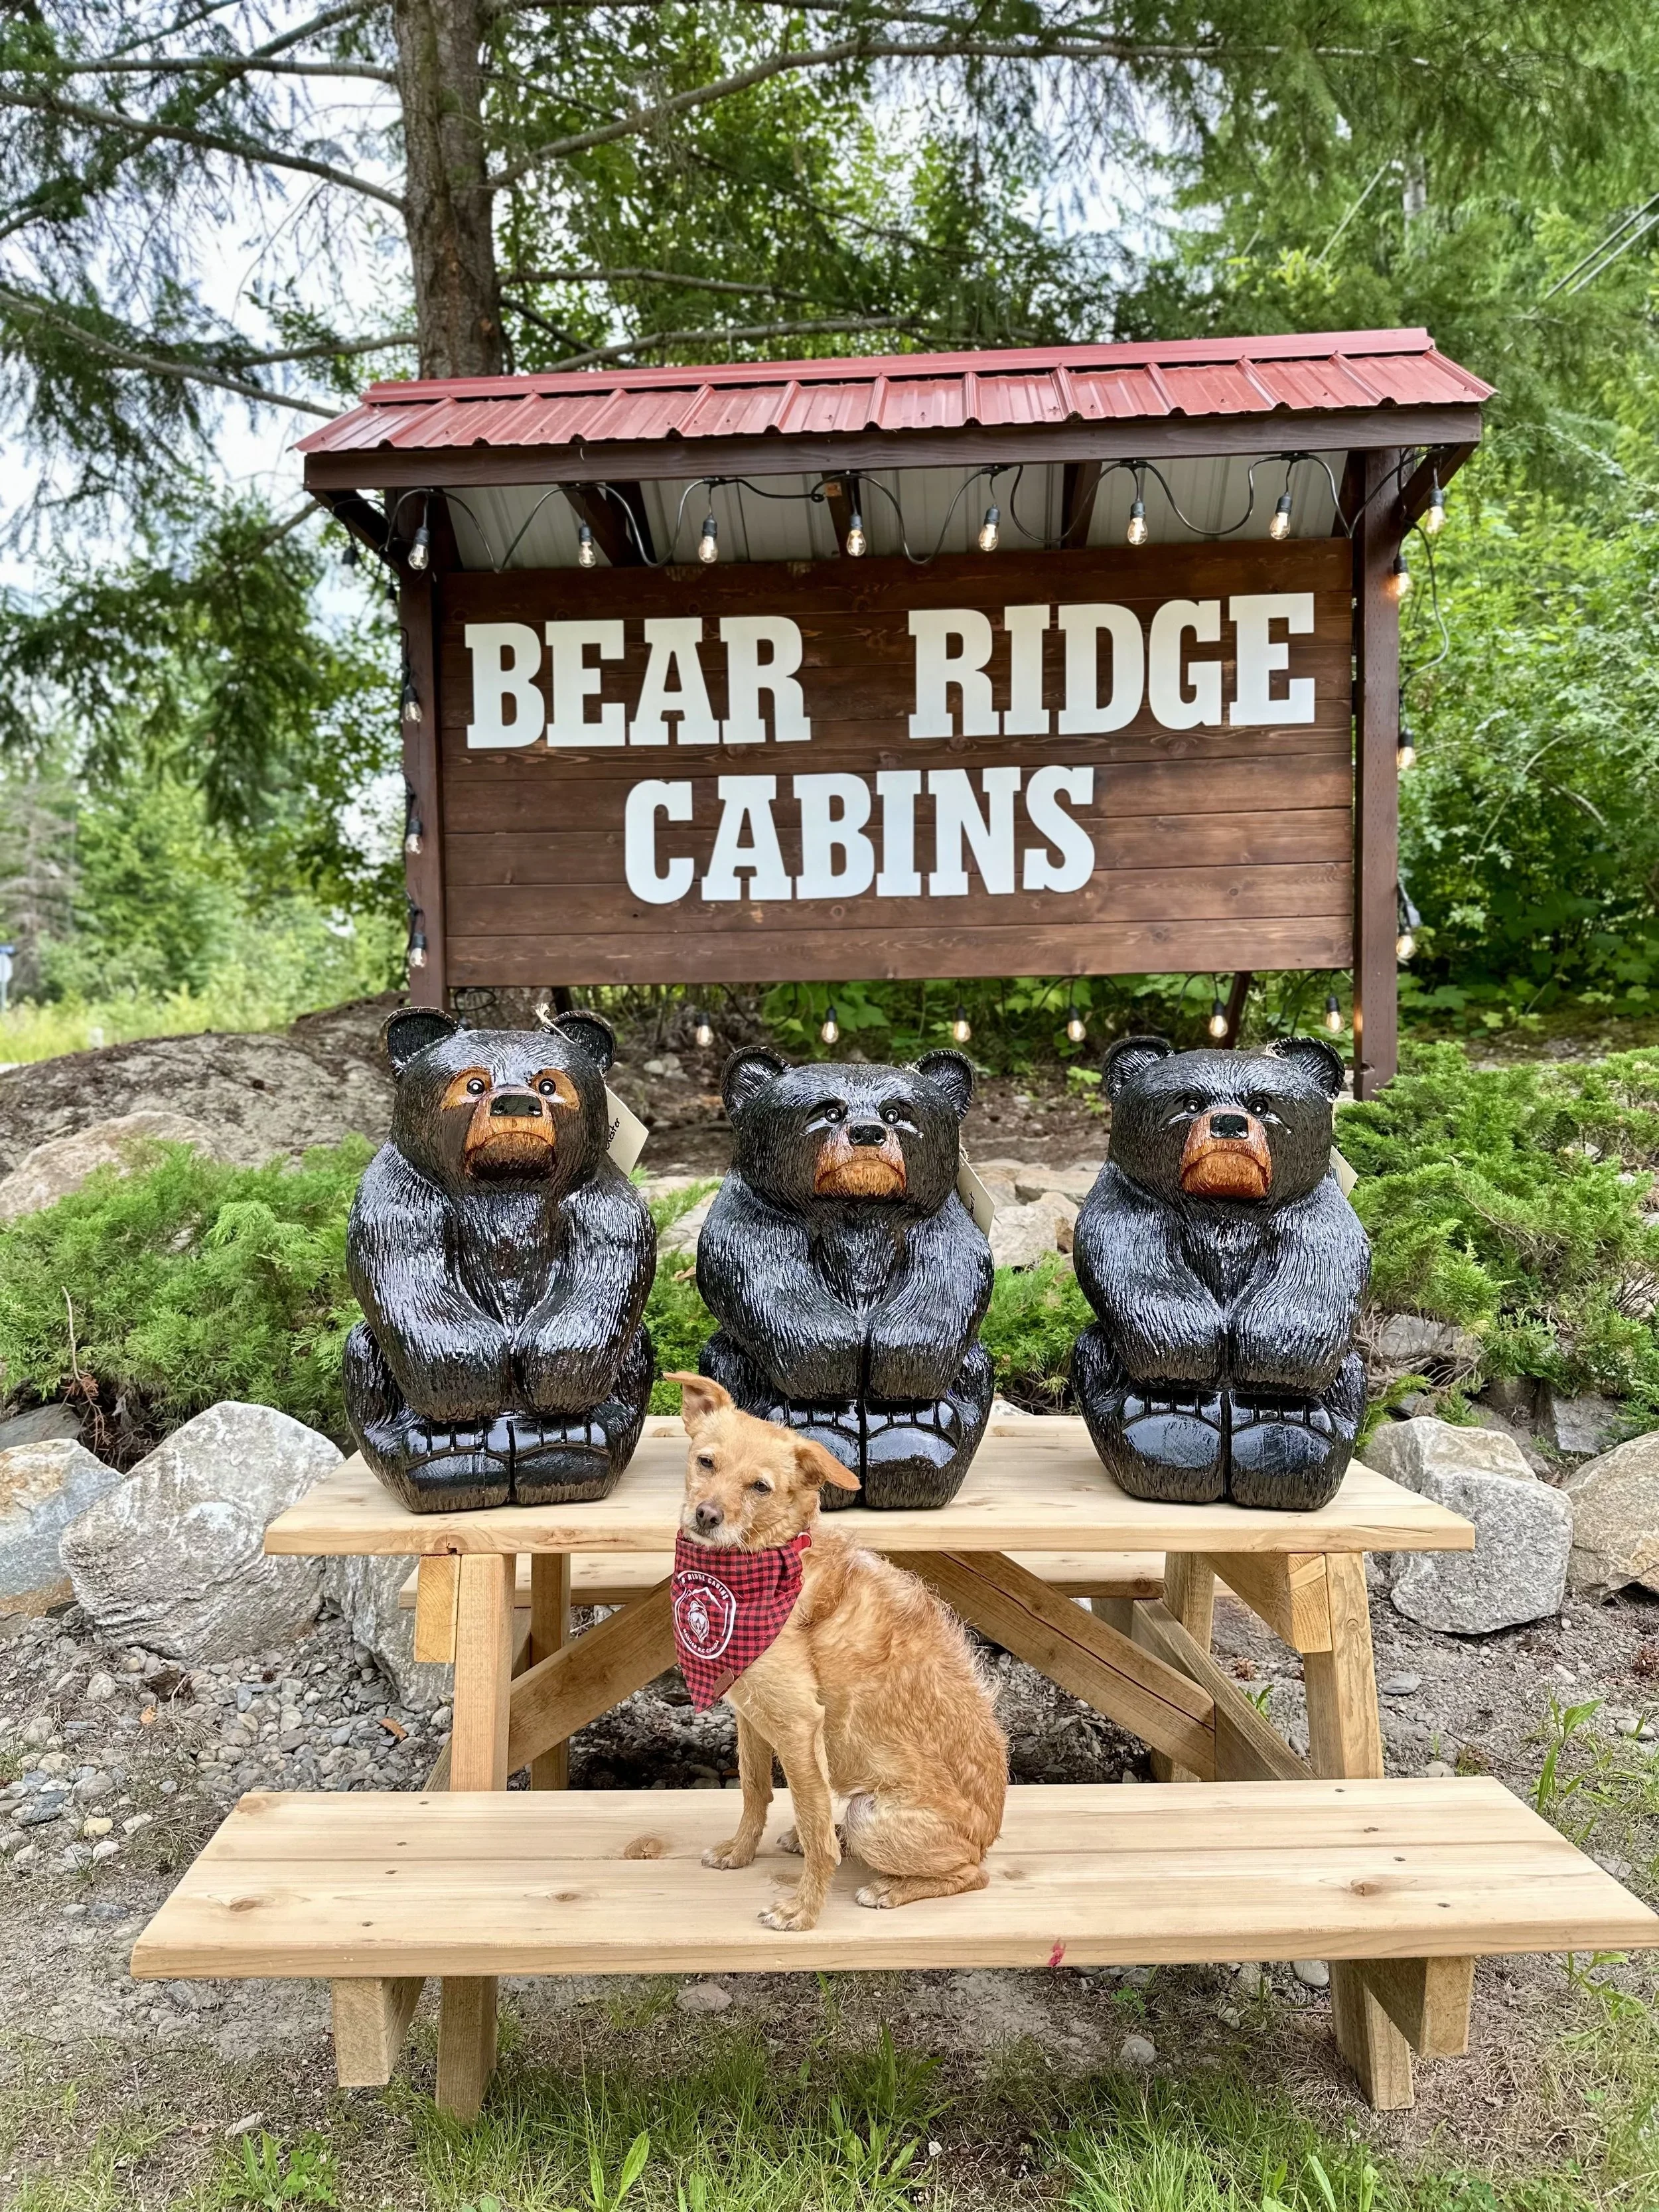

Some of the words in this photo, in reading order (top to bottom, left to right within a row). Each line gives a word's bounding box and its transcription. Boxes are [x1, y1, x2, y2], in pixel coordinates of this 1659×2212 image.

[465, 616, 811, 749] BEAR
[908, 593, 1315, 739] RIDGE
[624, 765, 1095, 904] CABINS
[707, 1578, 729, 1599] CABINS
[705, 1640, 720, 1653] CANADA
